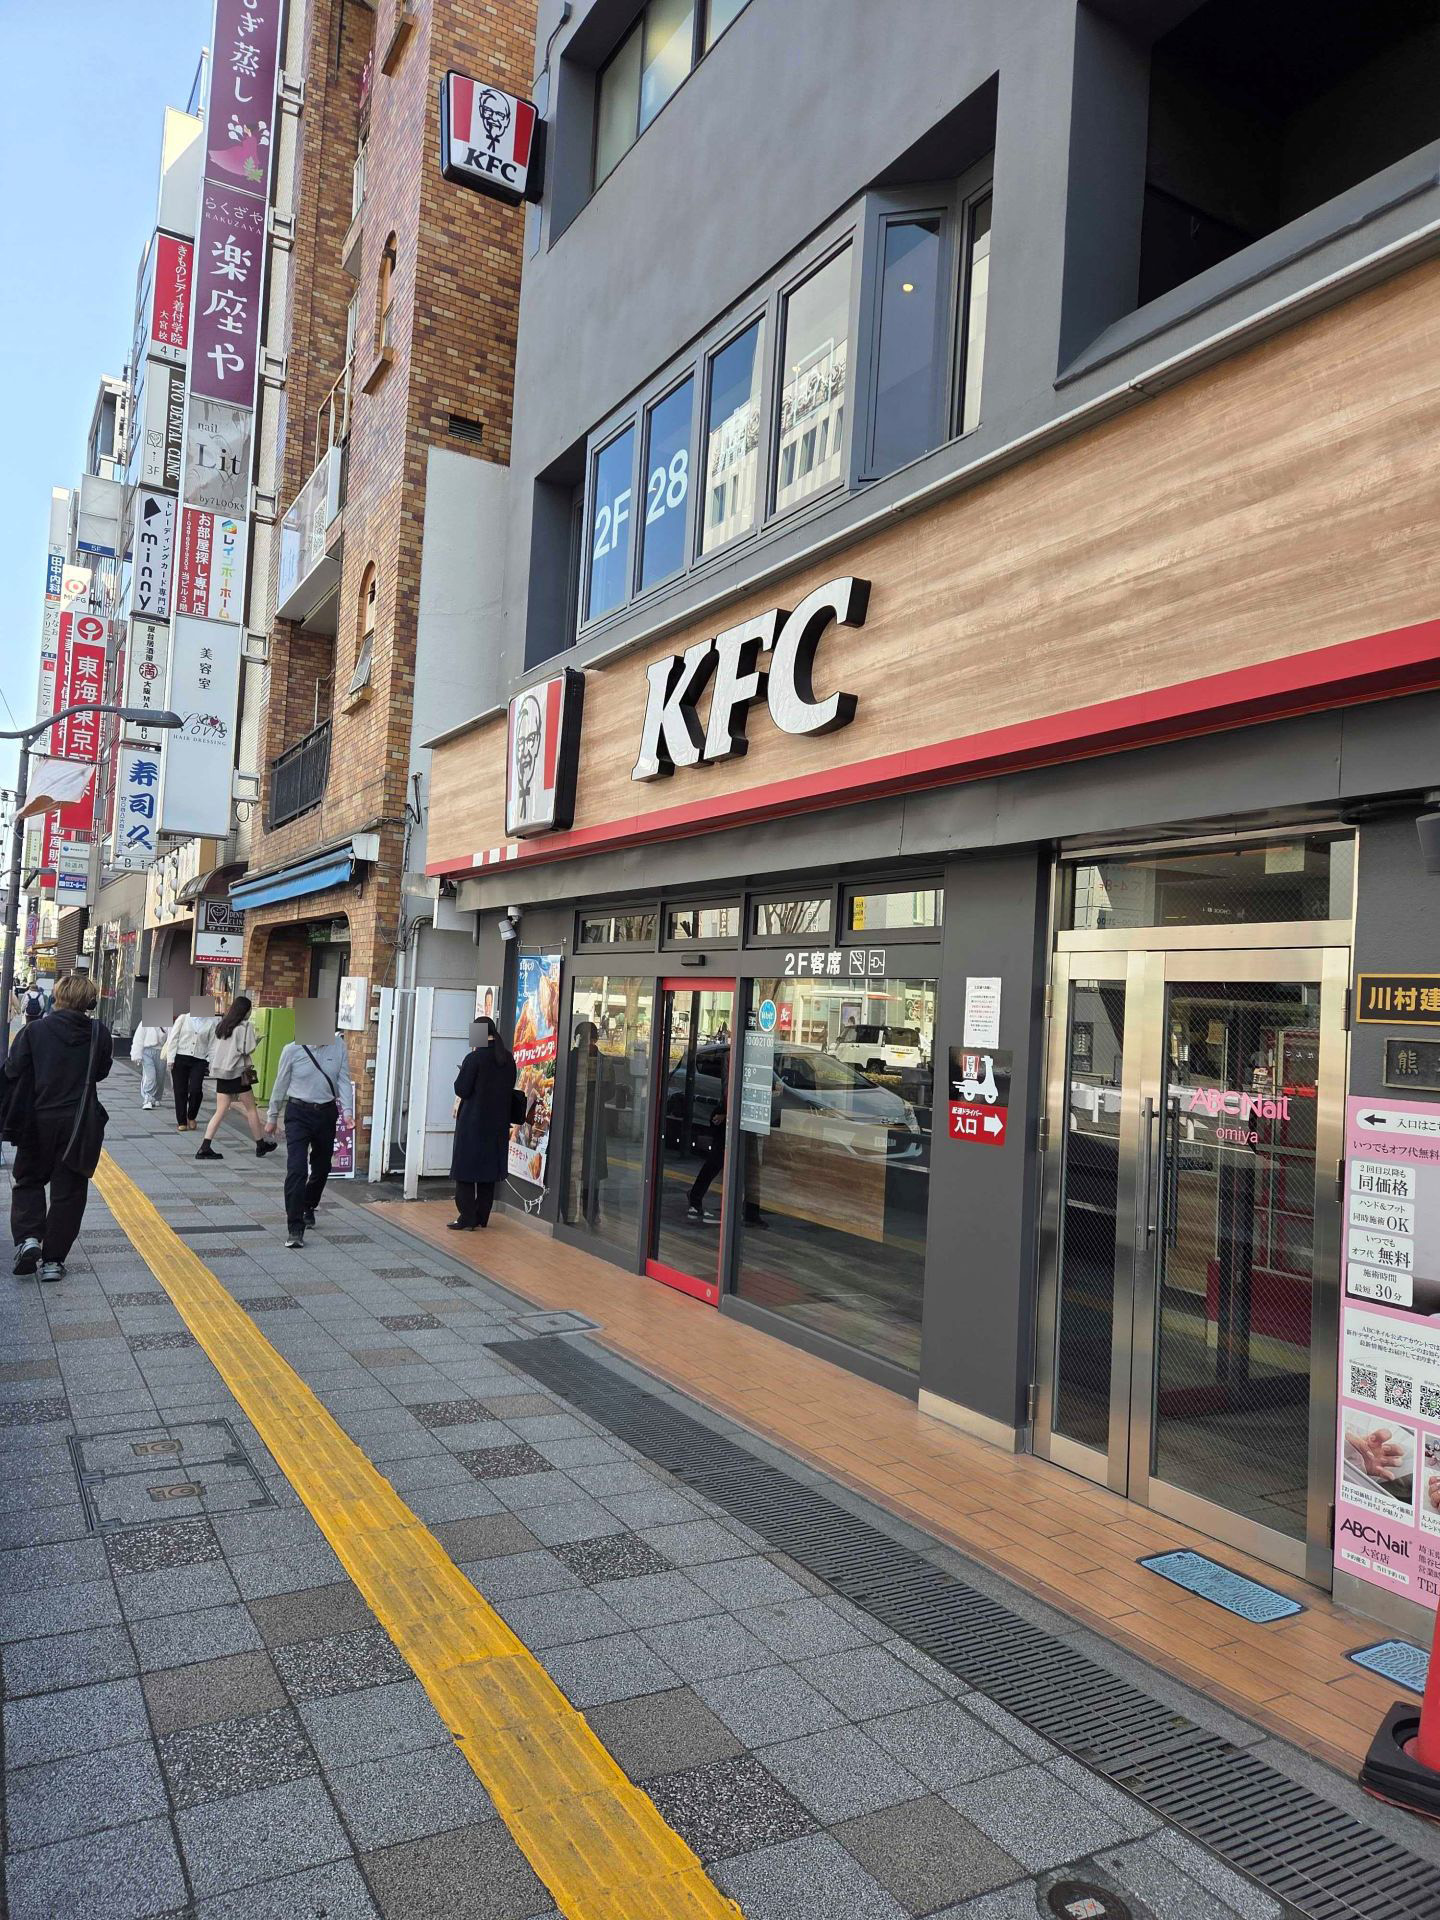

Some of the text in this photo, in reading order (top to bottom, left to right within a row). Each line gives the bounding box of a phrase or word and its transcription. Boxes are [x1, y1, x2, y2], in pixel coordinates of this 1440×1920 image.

[463, 147, 517, 183] KFC
[205, 196, 263, 225] らくざや
[205, 211, 261, 235] RAKUZAYA
[202, 234, 252, 380] 楽座や
[166, 379, 185, 480] RYO DENTAL CLINIC
[197, 422, 218, 434] nail
[147, 465, 160, 475] 3F
[195, 443, 241, 475] Lit
[156, 501, 172, 615] トレーディングカード専門店
[193, 513, 211, 616] お部屋探し専門店
[49, 556, 62, 593] 田中内科
[219, 534, 235, 618] レインボーホーム
[63, 594, 86, 604] MUFG
[198, 647, 213, 690] 美容室
[631, 575, 868, 783] KFC
[193, 737, 226, 746] DRESSING
[954, 1116, 977, 1135] 入口
[1216, 1126, 1259, 1146] omiya
[1353, 1140, 1439, 1160] いつでもオフ代無料
[1360, 1164, 1406, 1178] 2回目以降も
[1358, 1174, 1409, 1197] 同価格
[1366, 1235, 1396, 1248] いつでも
[1363, 1269, 1397, 1284] 施術時間
[1361, 1545, 1390, 1565] 大宮店
